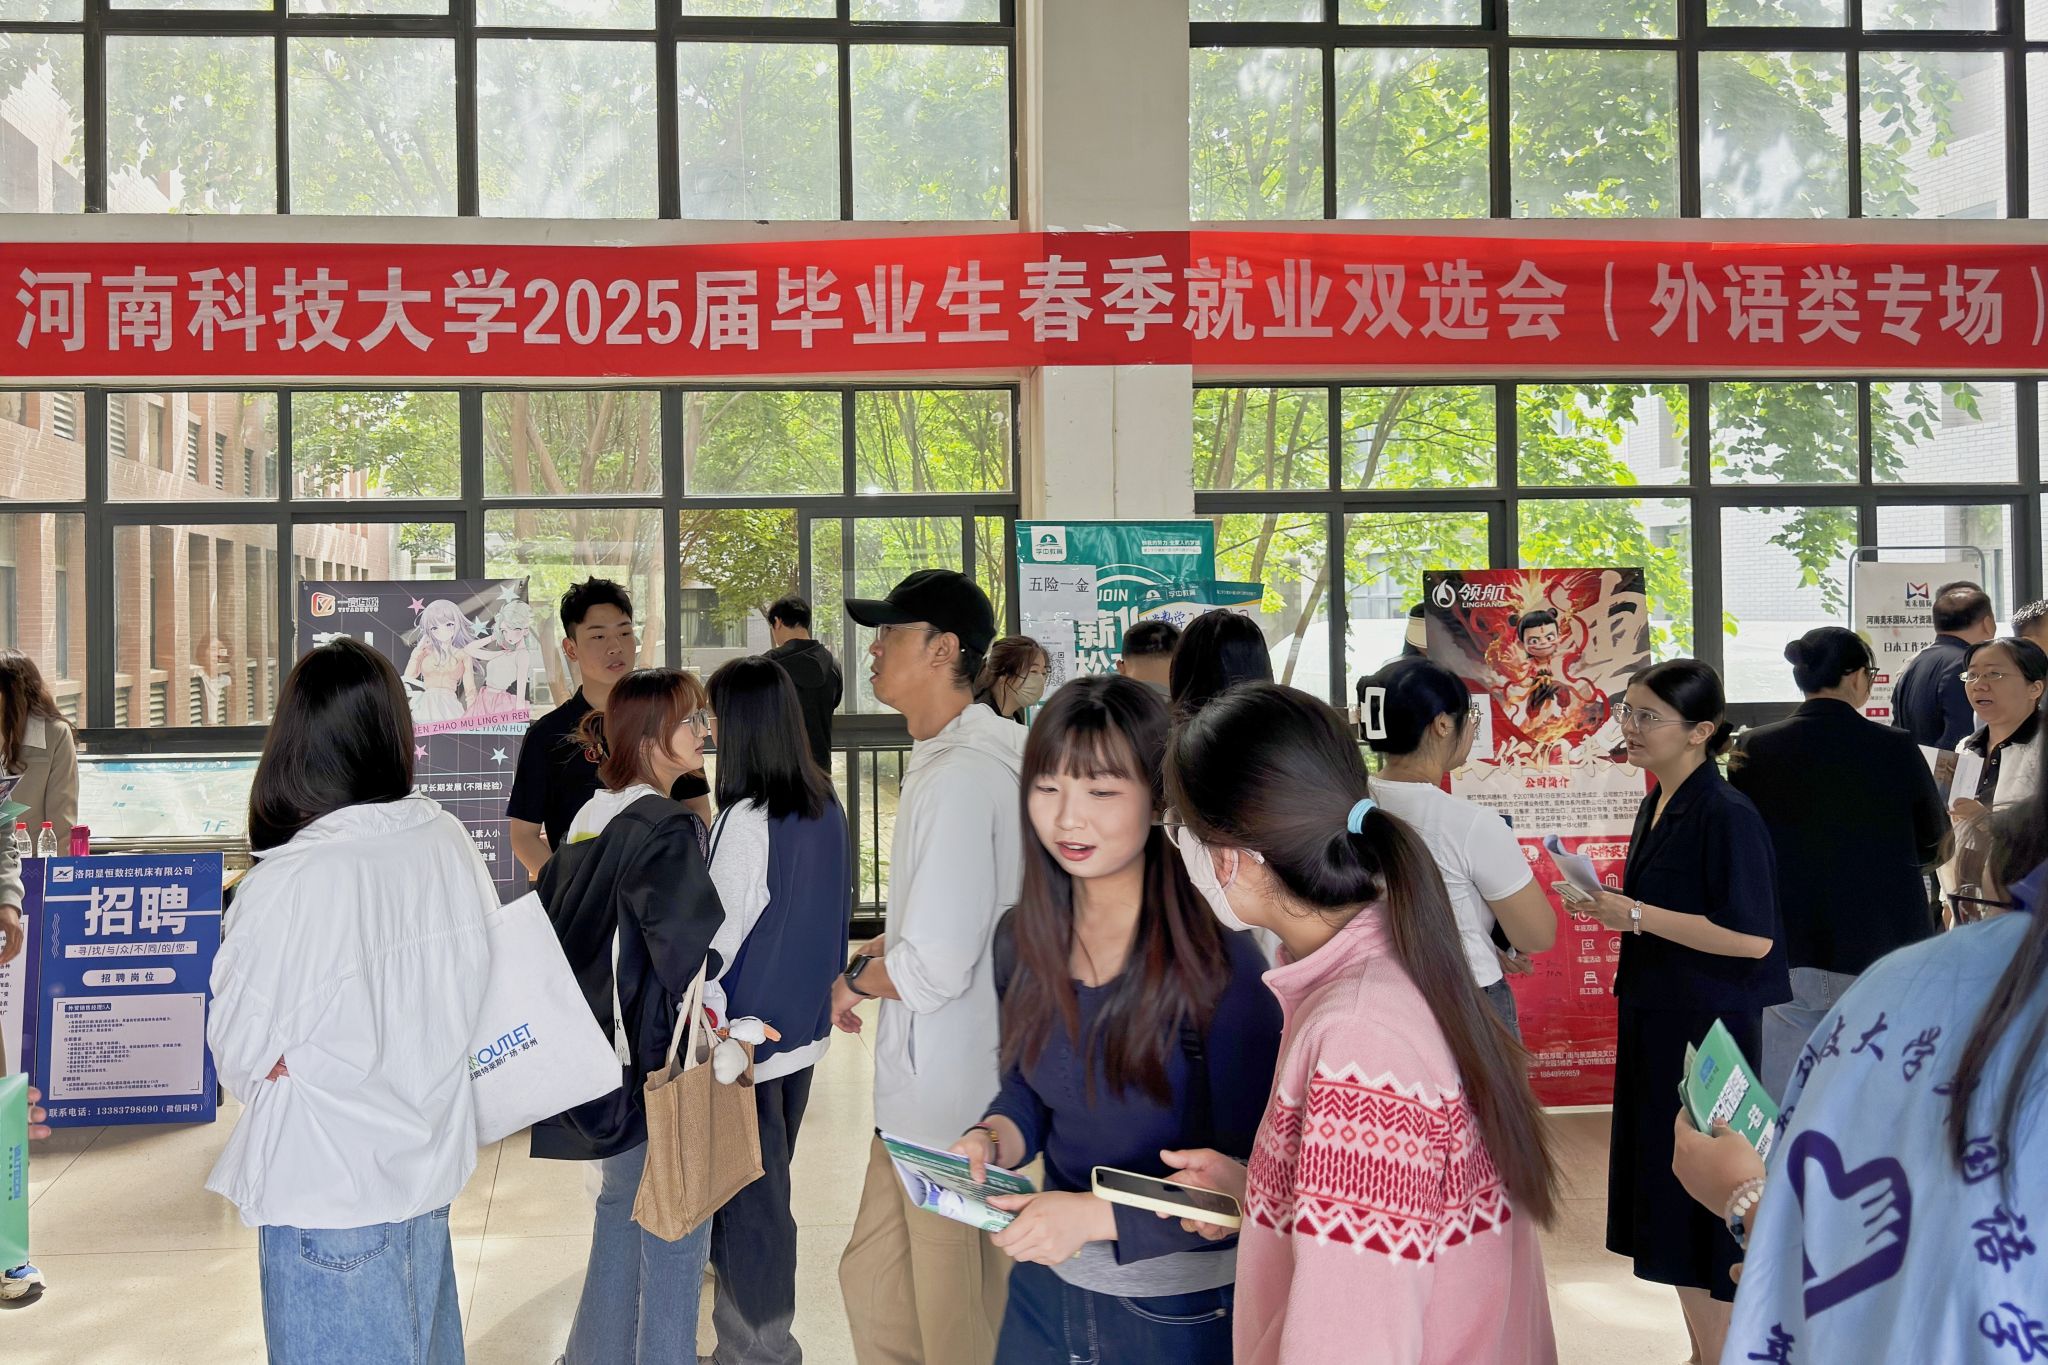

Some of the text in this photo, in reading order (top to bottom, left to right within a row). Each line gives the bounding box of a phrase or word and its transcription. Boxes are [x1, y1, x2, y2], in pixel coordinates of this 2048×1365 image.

[14, 254, 2046, 353] 河南科技大学2025届毕业生春季就业双选会（外语类专场）
[1028, 576, 1089, 593] 五险一金
[1458, 583, 1506, 601] 领航
[1097, 588, 1128, 602] JOIN
[433, 721, 458, 732] ZHAO
[460, 718, 474, 728] MU
[477, 715, 498, 726] LING
[501, 713, 509, 722] YI
[512, 711, 530, 720] REN
[1525, 776, 1571, 789] 公司简介
[84, 884, 189, 936] 招聘
[101, 971, 155, 983] 招聘岗位
